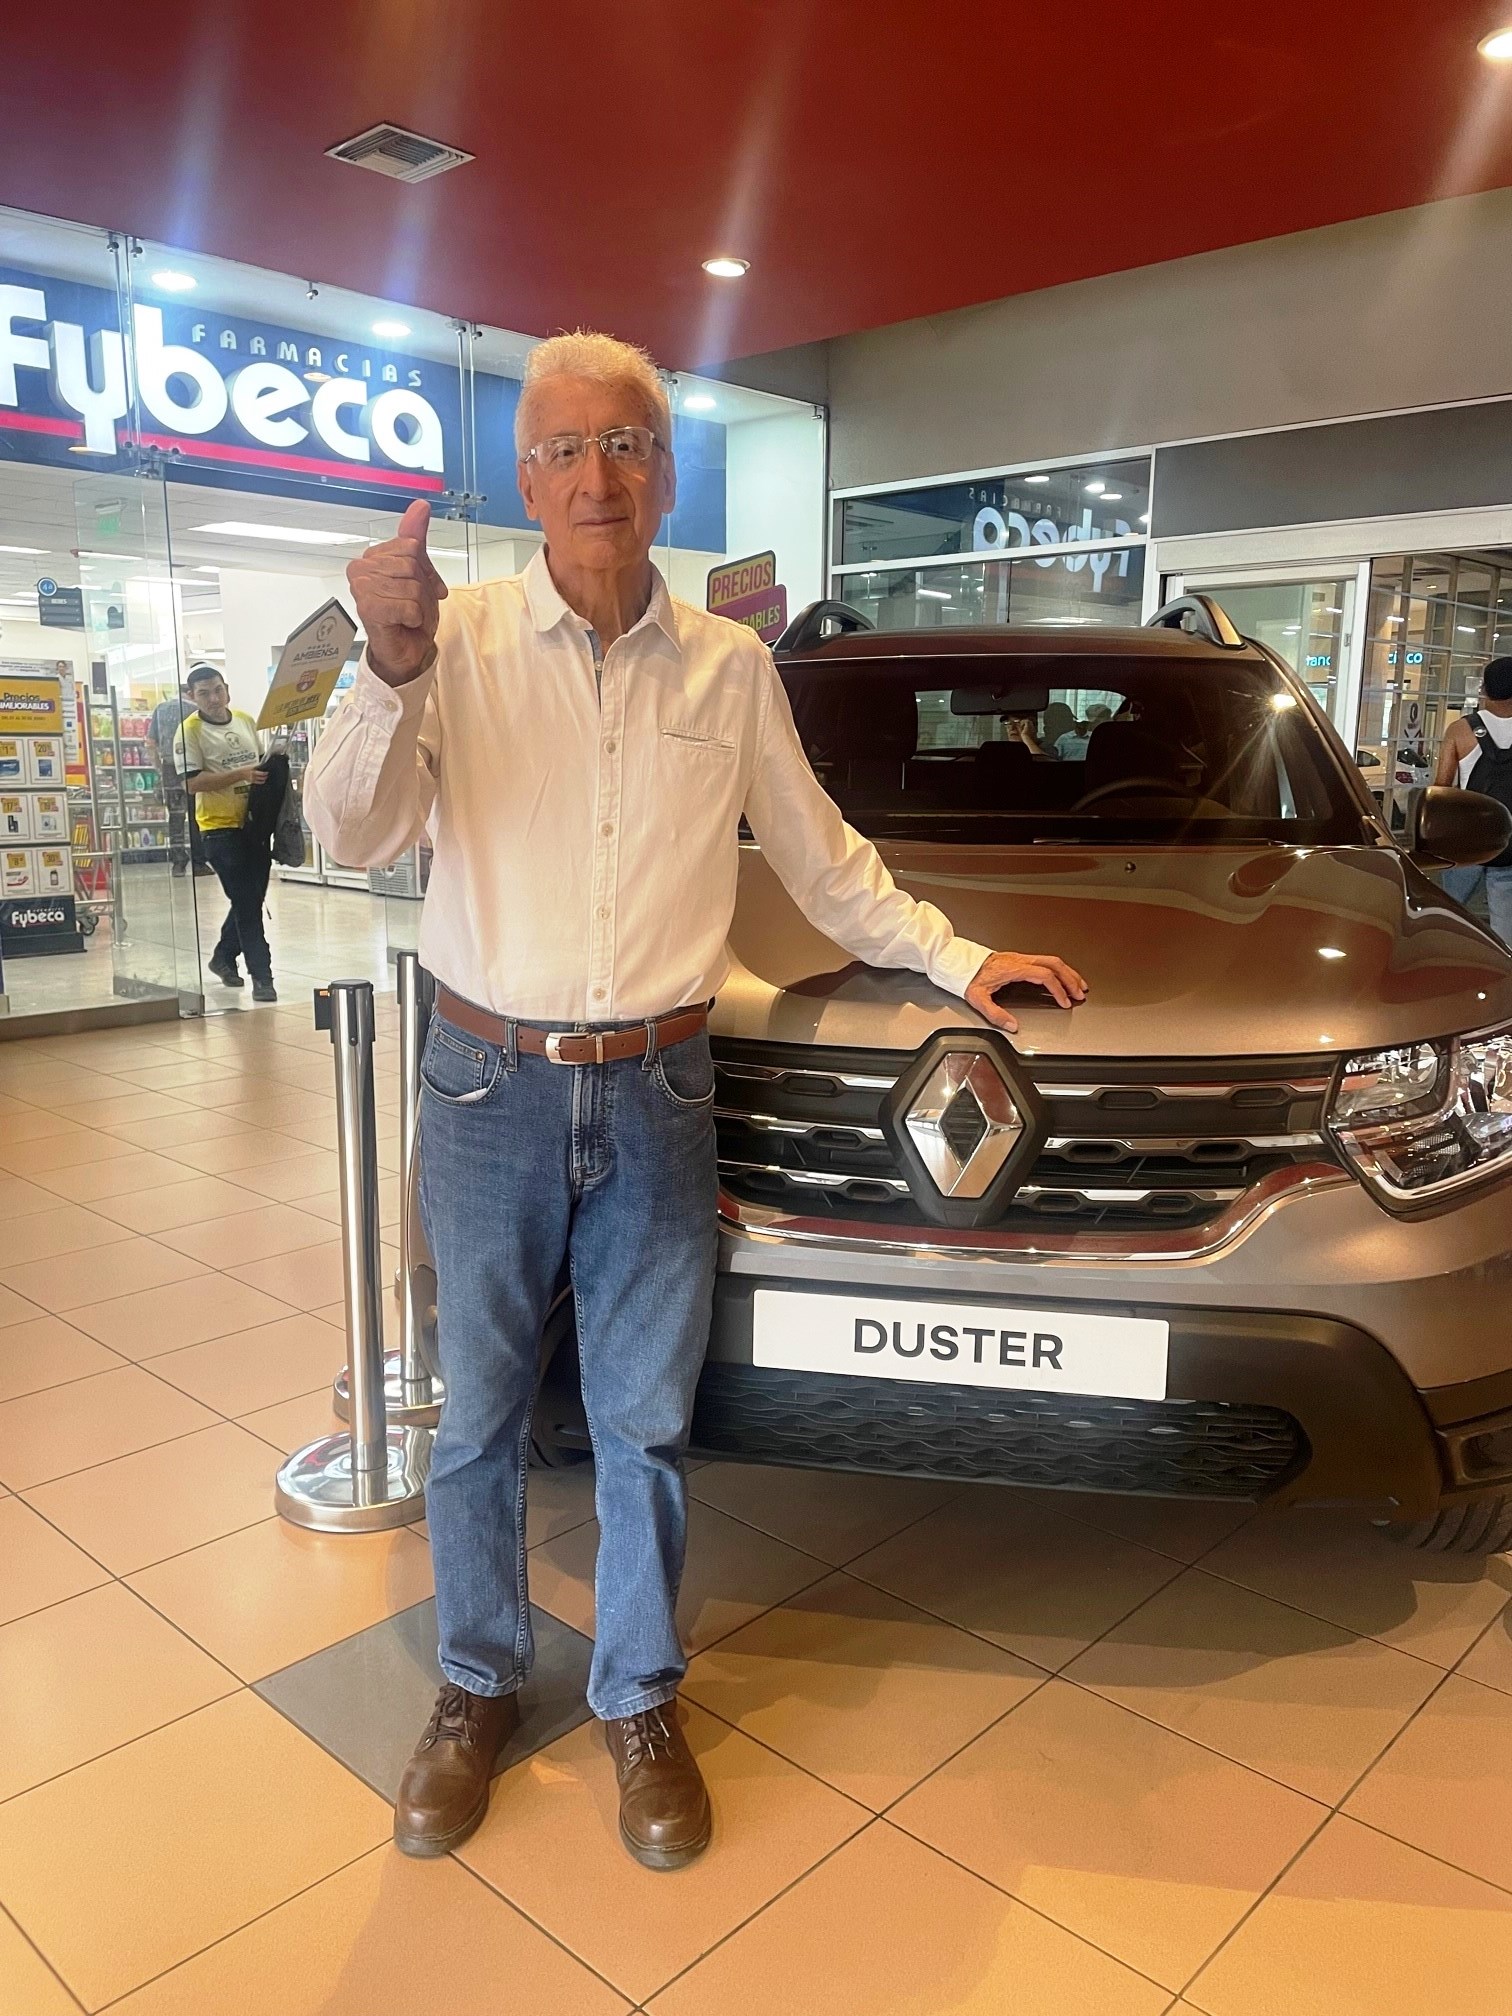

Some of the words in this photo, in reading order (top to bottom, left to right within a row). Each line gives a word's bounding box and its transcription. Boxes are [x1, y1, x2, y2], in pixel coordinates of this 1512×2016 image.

[191, 323, 422, 387] FARMACIAS
[0, 283, 445, 473] fybeca
[711, 560, 772, 604] PRECIOS
[292, 647, 340, 662] AMBIENSA
[3, 692, 40, 702] Precios
[11, 909, 65, 928] fybeca
[853, 1318, 1064, 1370] DUSTER
